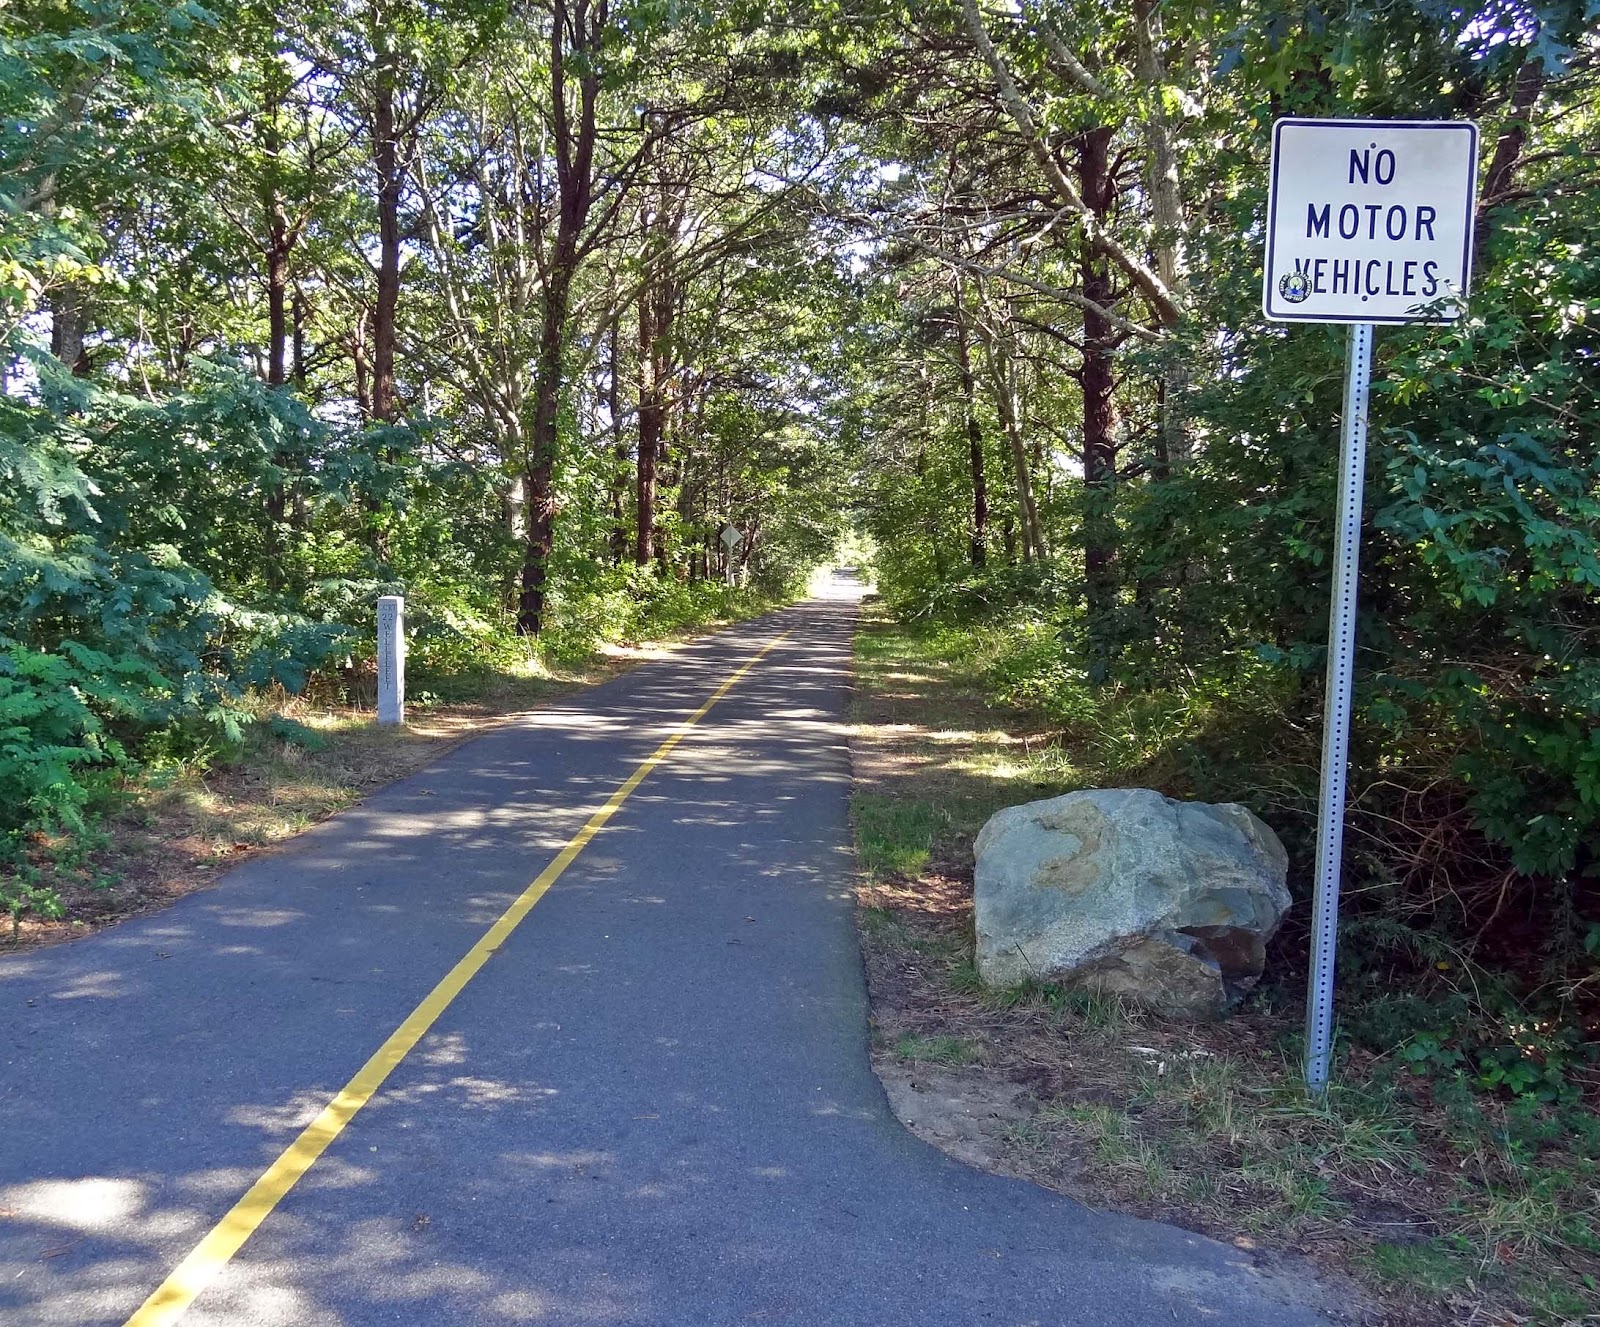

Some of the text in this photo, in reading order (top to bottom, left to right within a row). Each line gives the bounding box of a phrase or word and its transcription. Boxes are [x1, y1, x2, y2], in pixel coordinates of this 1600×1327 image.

[1348, 148, 1396, 185] NO
[1306, 203, 1437, 241] MOTOR
[381, 613, 393, 621] 22
